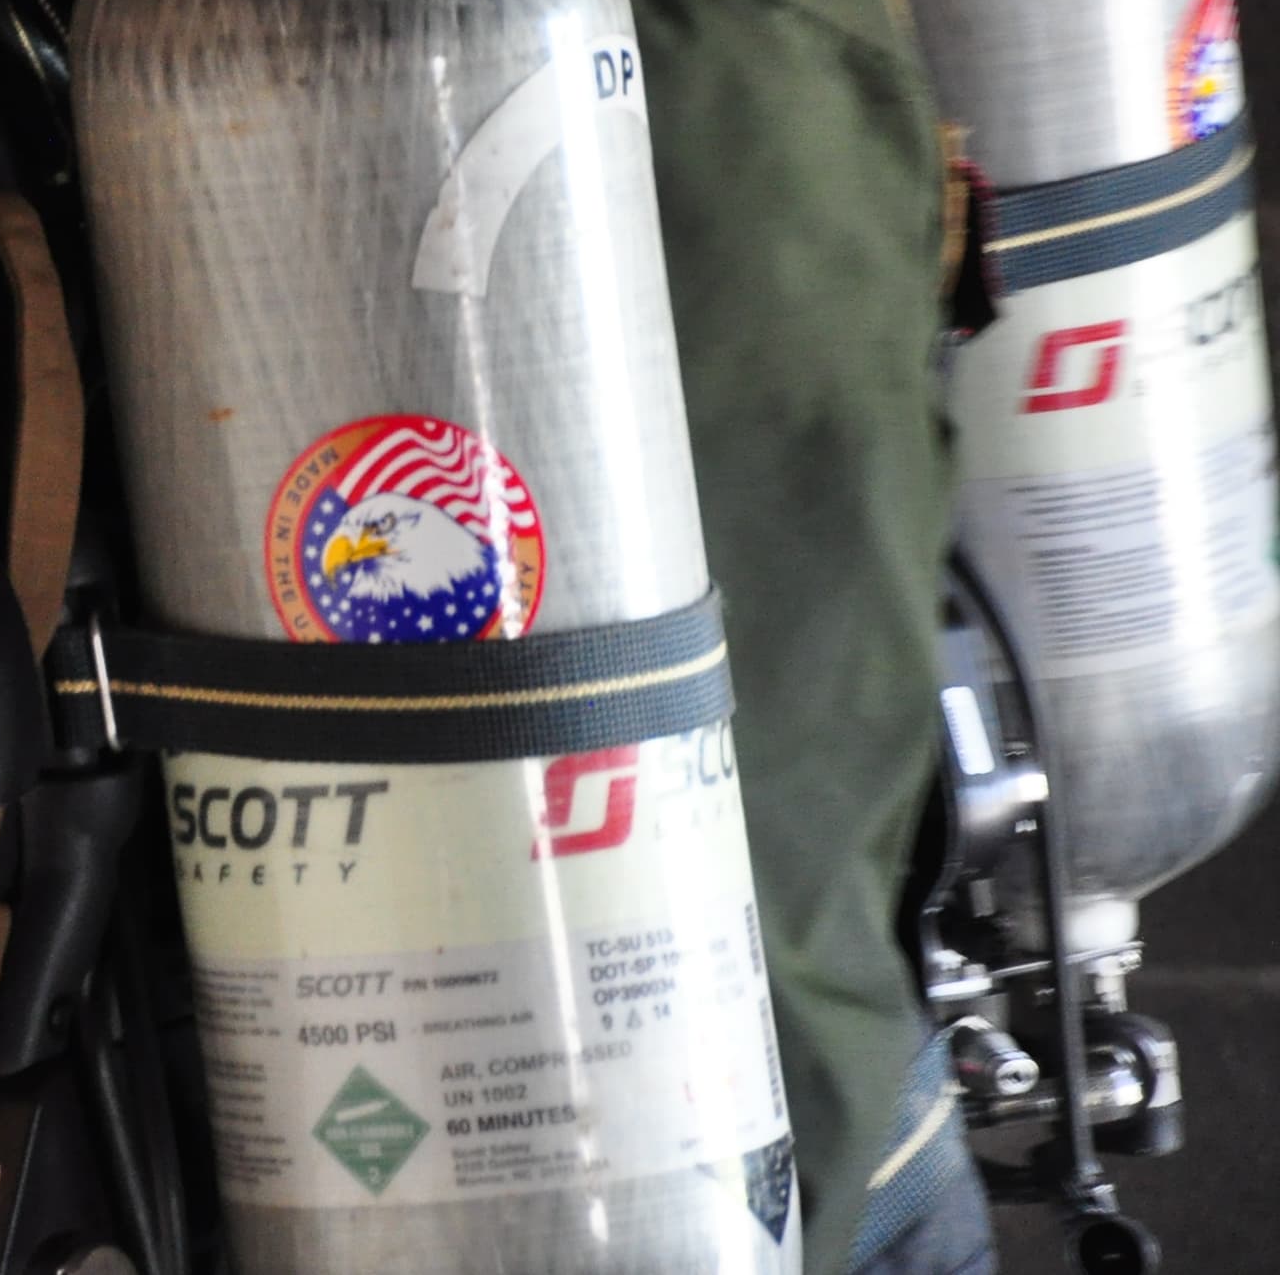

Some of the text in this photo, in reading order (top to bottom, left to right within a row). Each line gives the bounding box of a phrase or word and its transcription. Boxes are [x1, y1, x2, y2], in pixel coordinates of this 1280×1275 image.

[286, 446, 339, 505] MADE
[276, 516, 292, 541] IN
[275, 555, 298, 603] THE
[173, 781, 389, 850] SCOTT
[295, 971, 393, 998] SCOTT
[297, 1020, 397, 1047] 4500 PSI
[441, 1040, 633, 1082] AIR, COMPRSSED
[444, 1084, 528, 1107] UN 1002
[447, 1104, 577, 1136] 60 MINUTES
